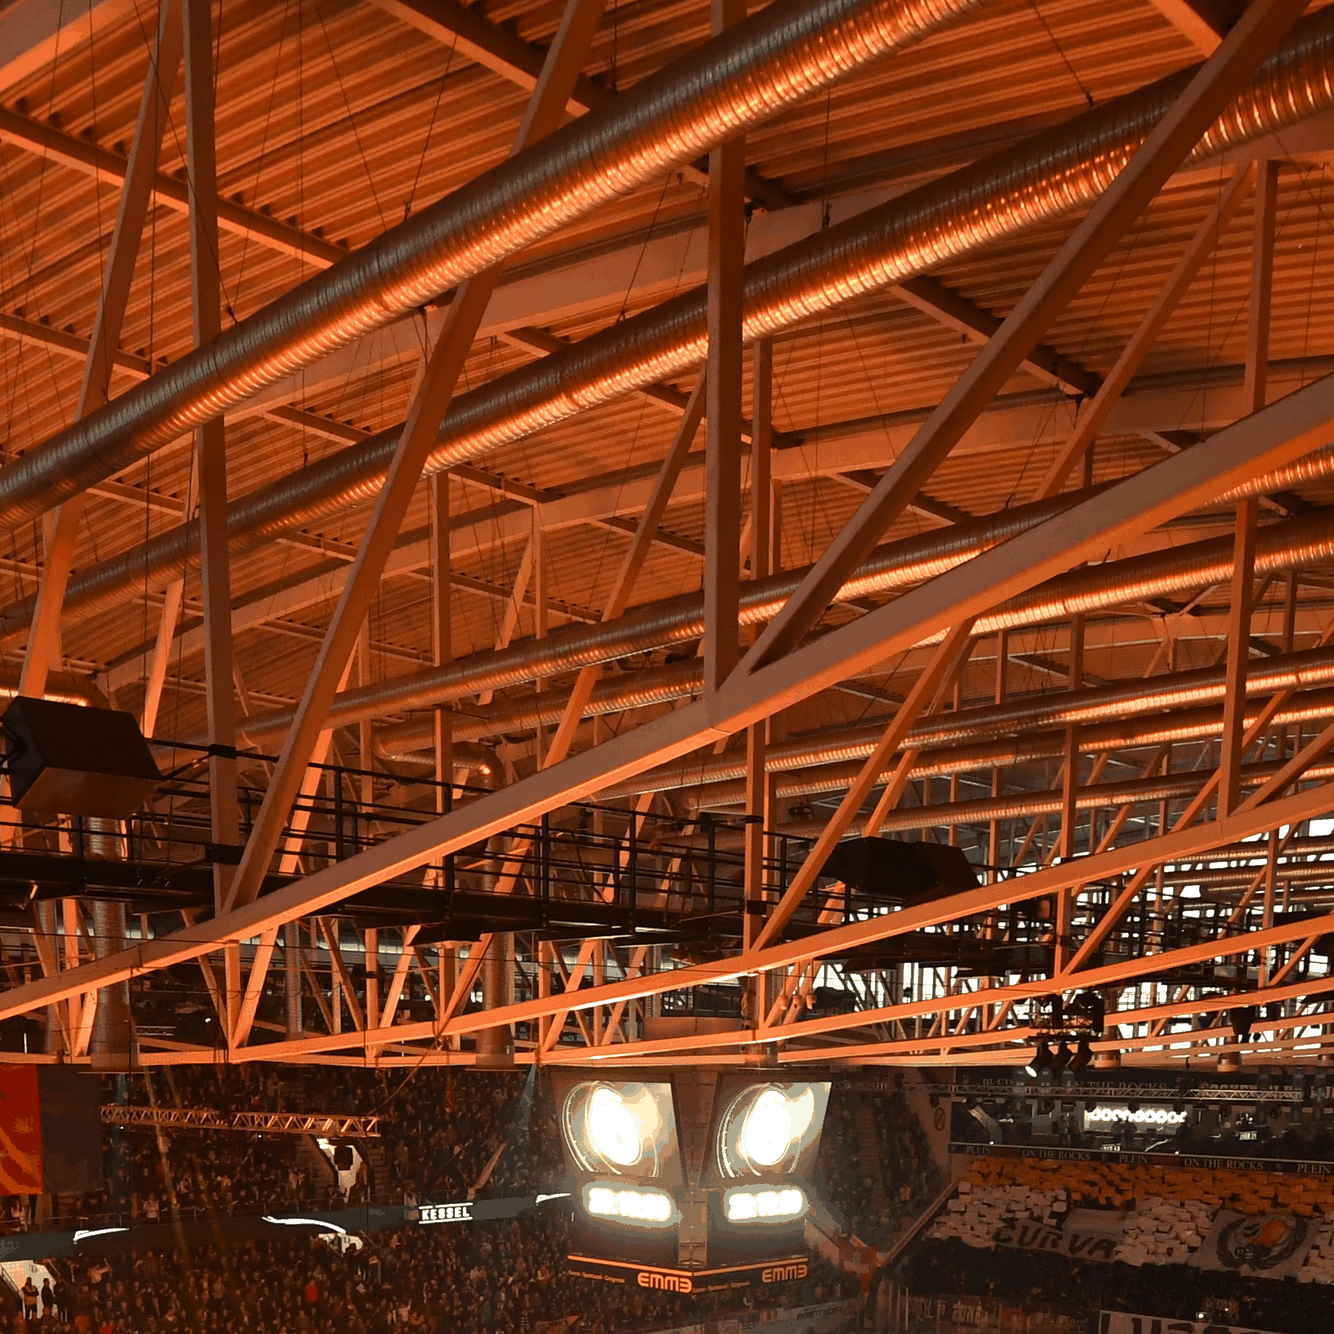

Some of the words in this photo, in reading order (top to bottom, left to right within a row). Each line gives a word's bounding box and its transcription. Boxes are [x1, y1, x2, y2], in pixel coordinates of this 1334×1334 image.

[1022, 1148, 1040, 1158] ON
[1041, 1149, 1058, 1159] THE
[1059, 1151, 1091, 1161] ROCKS
[1119, 1154, 1149, 1164] PLEIN
[1184, 1157, 1201, 1167] ON
[1203, 1158, 1225, 1168] THE
[1226, 1160, 1264, 1171] ROCKS
[1296, 1163, 1331, 1174] PLEIN
[422, 1206, 470, 1221] KESSEL
[992, 1223, 1118, 1259] CURVA
